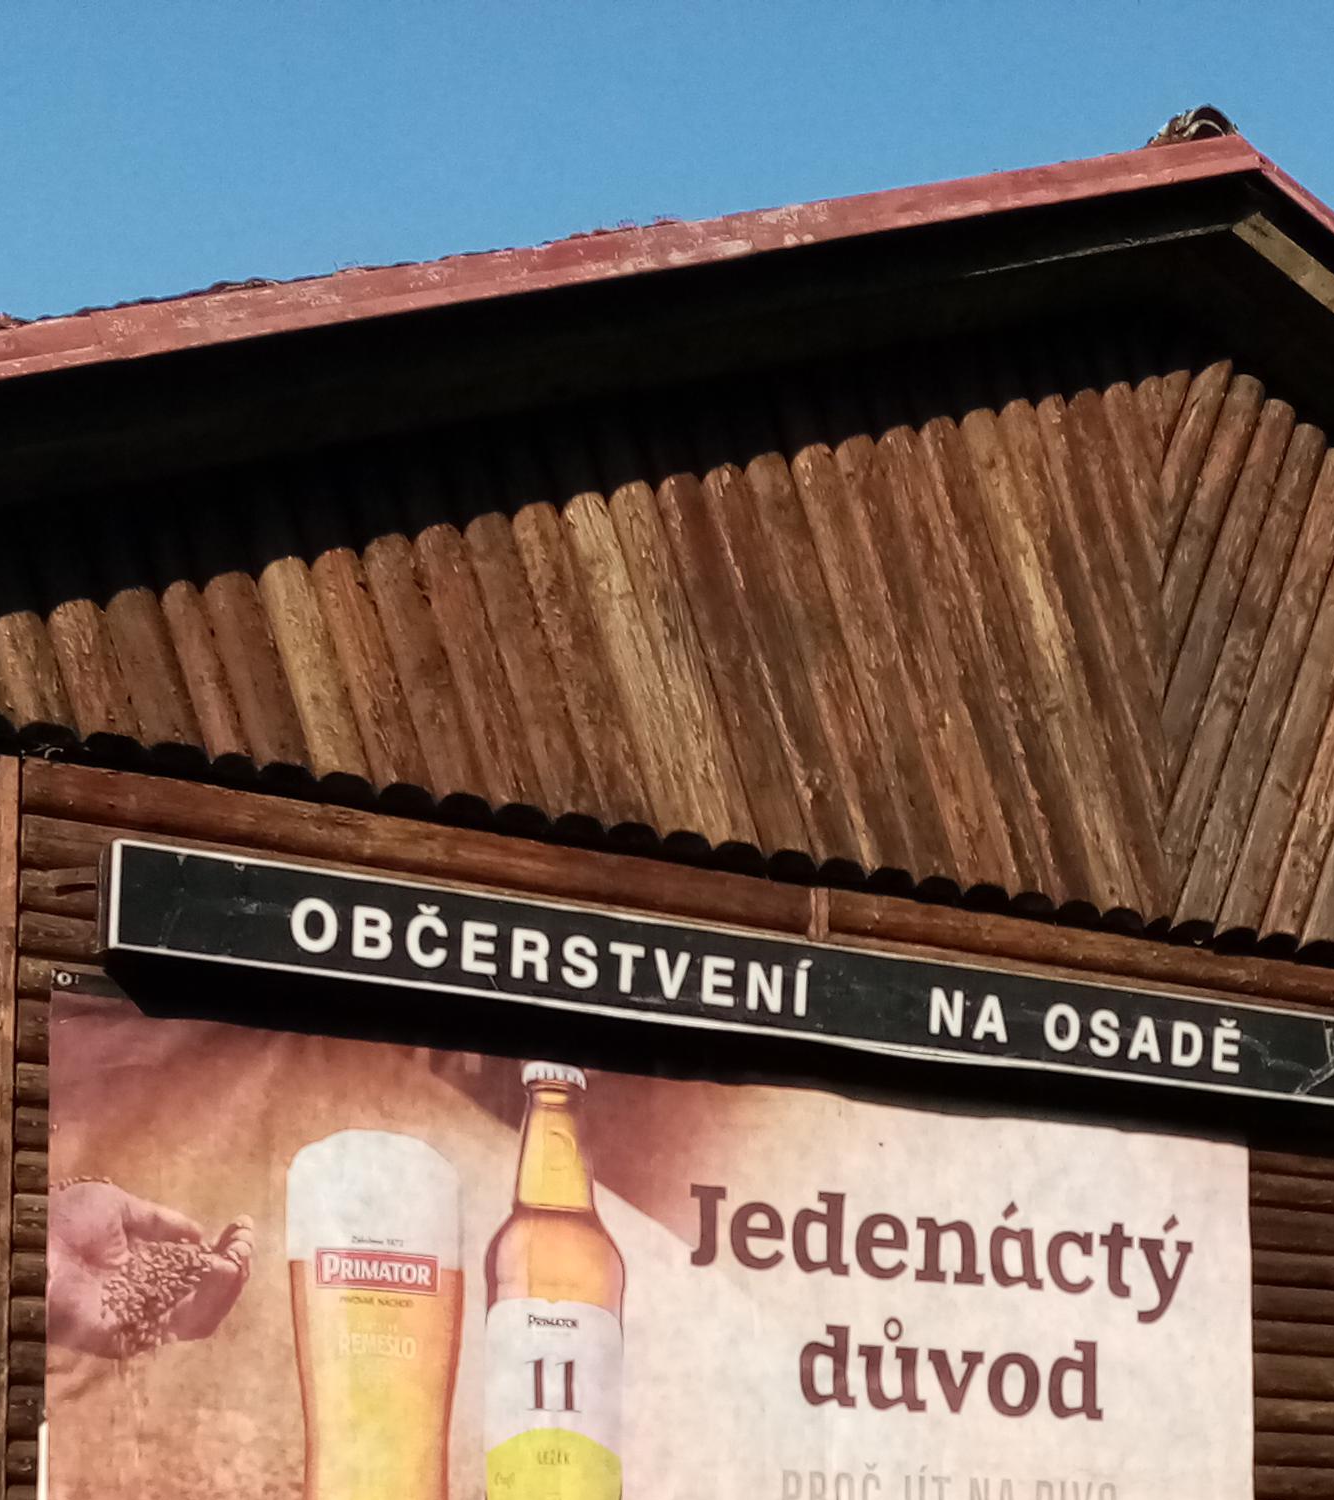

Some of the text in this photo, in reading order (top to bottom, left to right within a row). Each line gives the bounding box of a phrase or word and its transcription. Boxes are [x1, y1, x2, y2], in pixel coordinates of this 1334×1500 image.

[289, 897, 1242, 1074] OBČERSTVENÍ NA OSADĚ
[320, 1252, 433, 1288] PRIMATOR
[689, 1181, 1194, 1324] Jedenáctý
[524, 1357, 582, 1414] 11
[798, 1316, 1104, 1421] důvod
